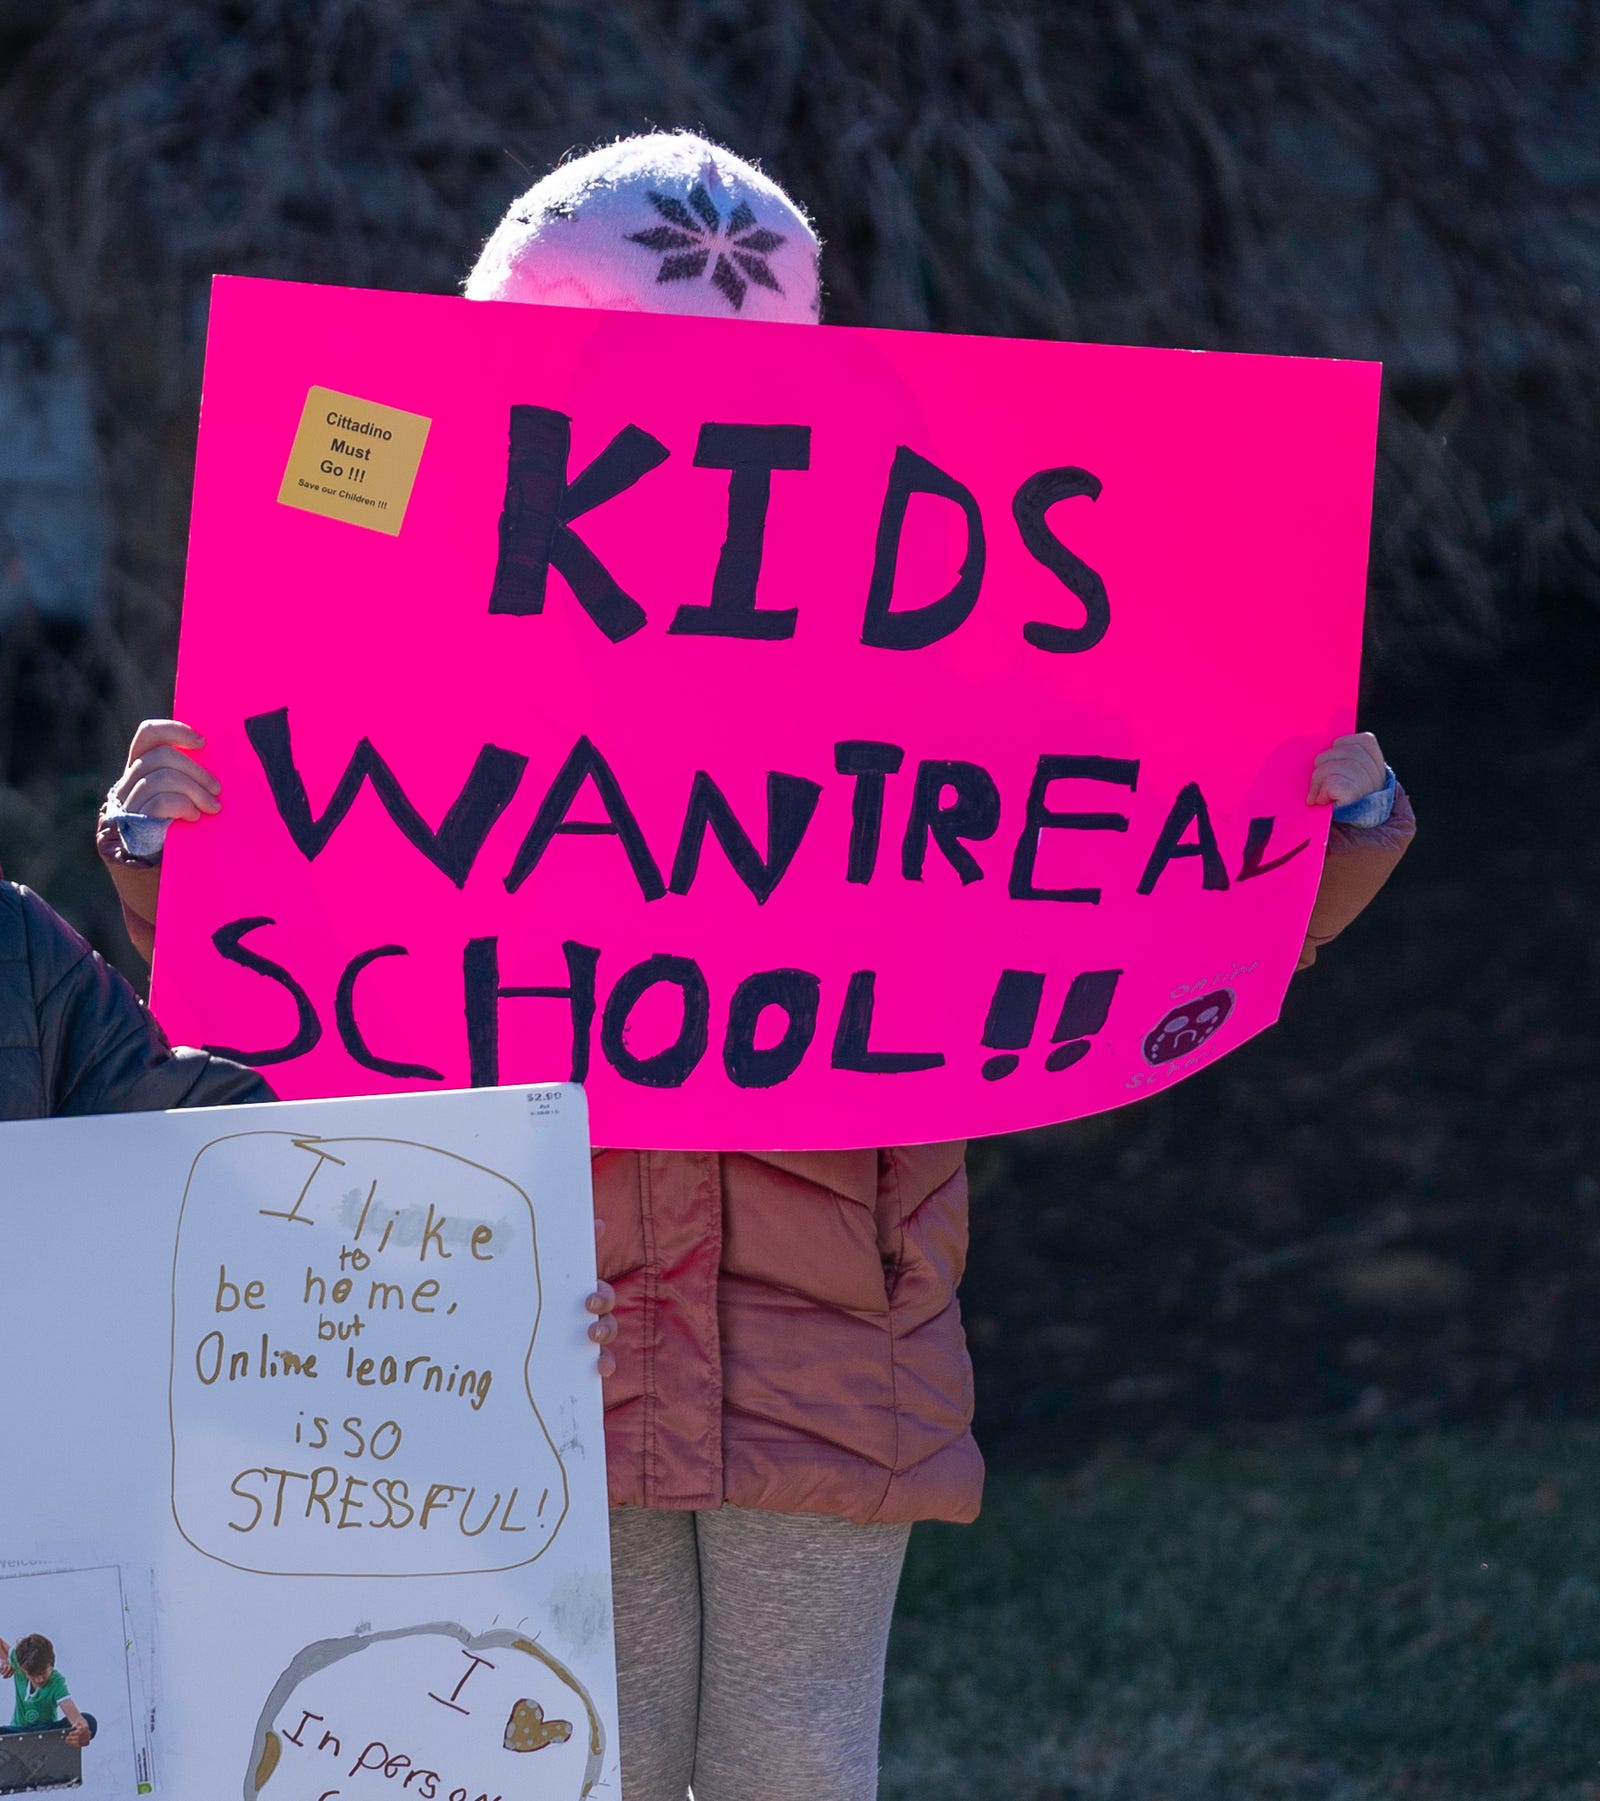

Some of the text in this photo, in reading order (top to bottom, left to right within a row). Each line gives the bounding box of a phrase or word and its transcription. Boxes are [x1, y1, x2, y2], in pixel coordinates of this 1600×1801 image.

[326, 411, 393, 441] Cittadino
[330, 438, 372, 461] Must
[320, 459, 343, 477] Go
[298, 478, 320, 491] Save
[321, 485, 337, 496] our
[338, 489, 376, 508] Children
[488, 404, 1111, 654] KIDS
[259, 1139, 494, 1262] I like
[338, 1244, 371, 1272] to
[215, 1264, 267, 1313] be
[318, 1313, 366, 1341] but
[196, 1330, 492, 1410] Online learning
[229, 1466, 549, 1536] STRESSFUL!
[427, 1649, 495, 1715] I
[281, 1709, 341, 1756] In
